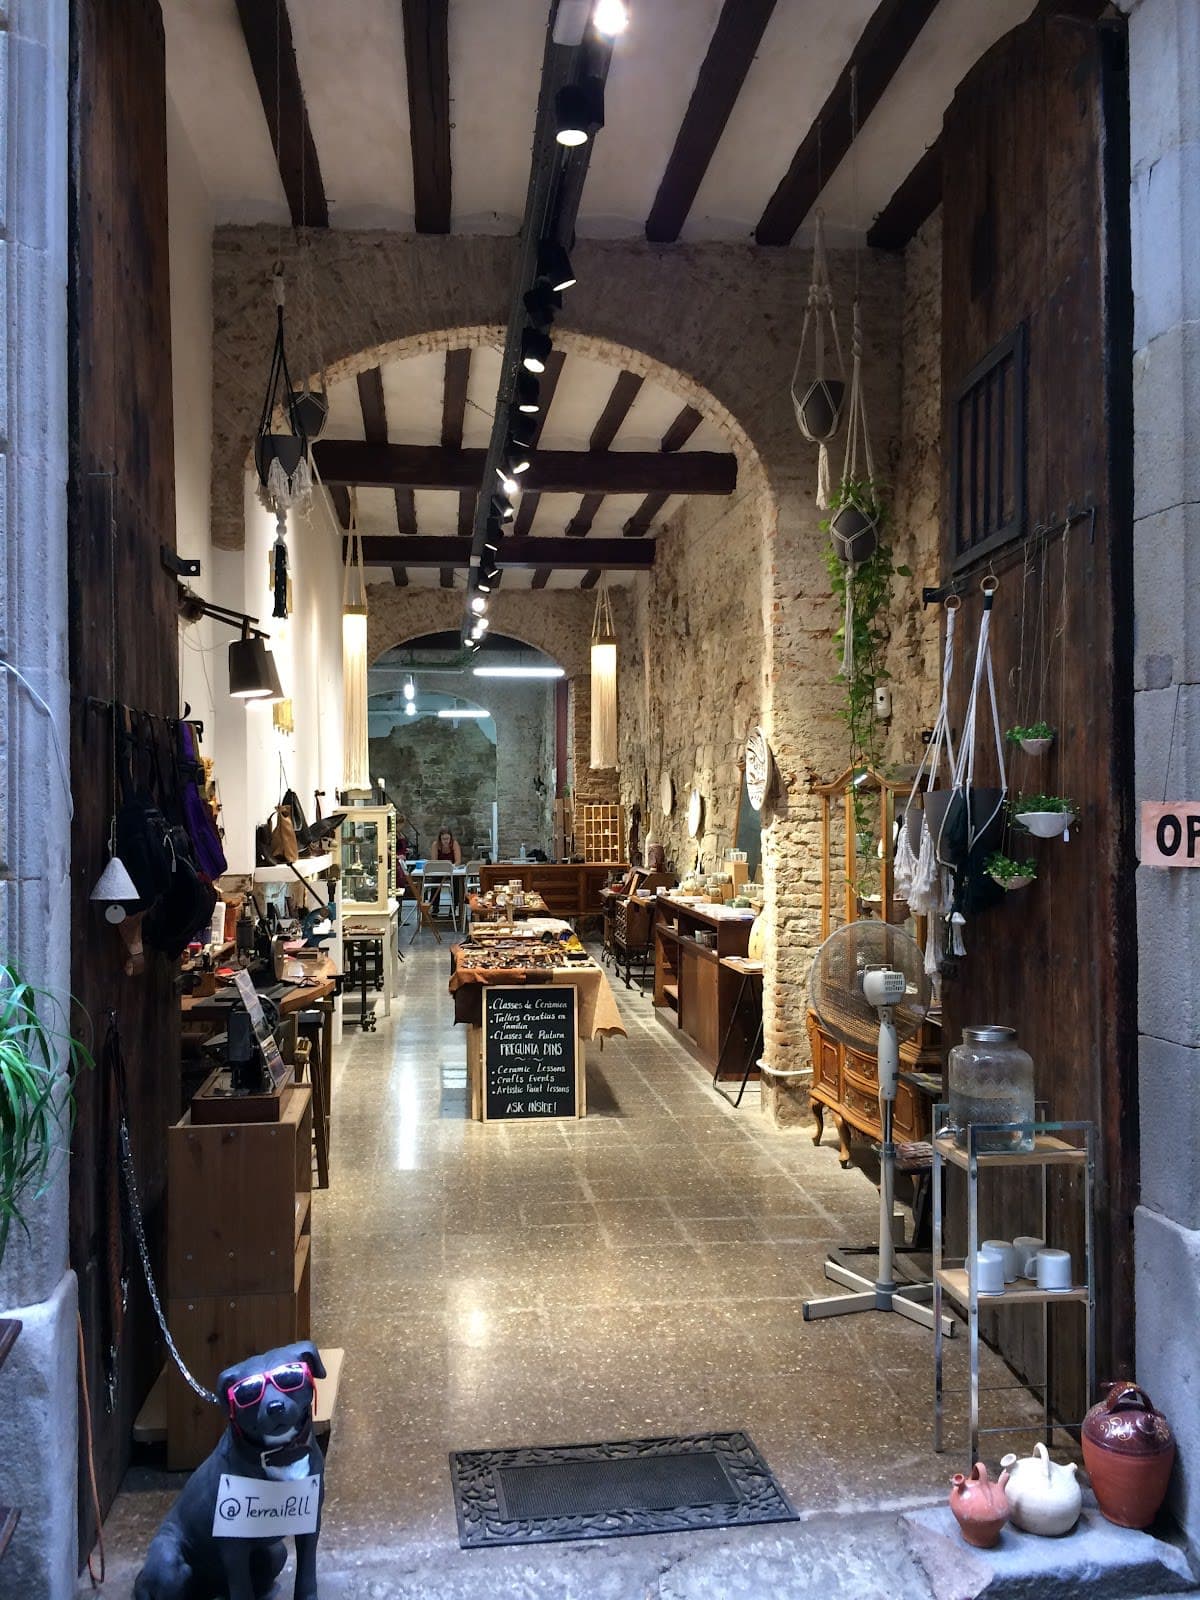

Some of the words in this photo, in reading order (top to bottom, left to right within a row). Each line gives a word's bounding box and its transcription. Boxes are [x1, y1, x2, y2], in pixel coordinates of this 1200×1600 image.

[492, 997, 523, 1009] Classes
[524, 1000, 532, 1009] de
[494, 1012, 520, 1023] Tallers
[494, 1030, 522, 1040] Classes
[525, 1030, 533, 1039] de
[500, 1043, 540, 1056] PREGUNTA
[543, 1043, 563, 1056] DINS
[497, 1065, 530, 1074] Ceramic
[537, 1063, 566, 1073] Lessons
[497, 1074, 524, 1084] Crafts
[529, 1074, 555, 1083] Events
[496, 1085, 524, 1095] Artistic
[526, 1084, 542, 1094] Paint
[506, 1101, 525, 1113] ASK
[528, 1100, 557, 1114] INSIDE!
